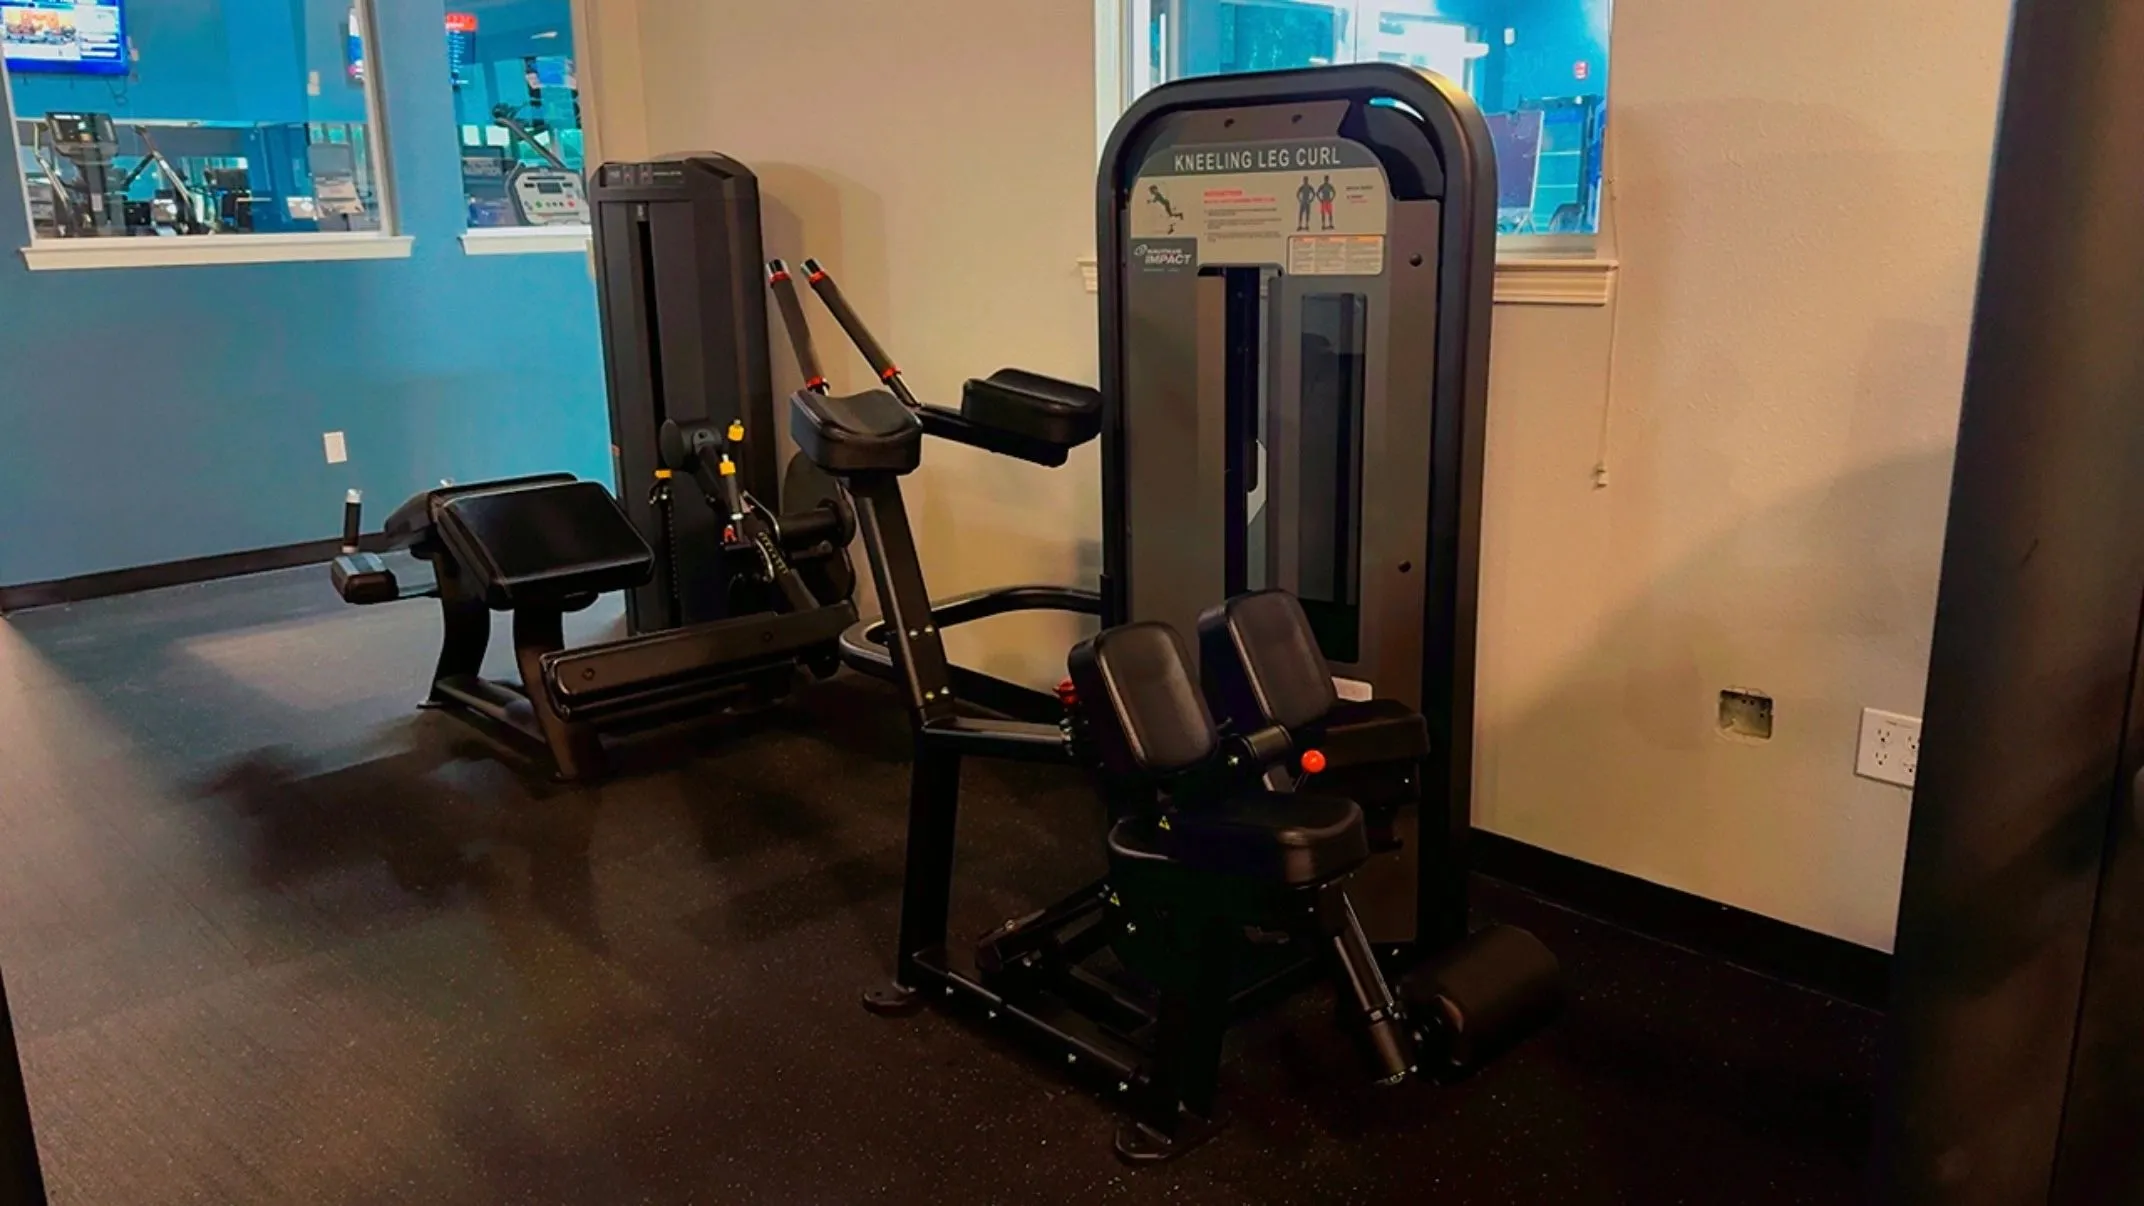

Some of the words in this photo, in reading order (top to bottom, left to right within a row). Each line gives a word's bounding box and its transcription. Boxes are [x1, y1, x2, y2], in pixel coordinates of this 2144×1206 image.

[1175, 152, 1252, 172] KNEELING
[1258, 149, 1289, 168] LEG
[1296, 146, 1341, 166] CURL
[1145, 254, 1192, 265] IMPACT
